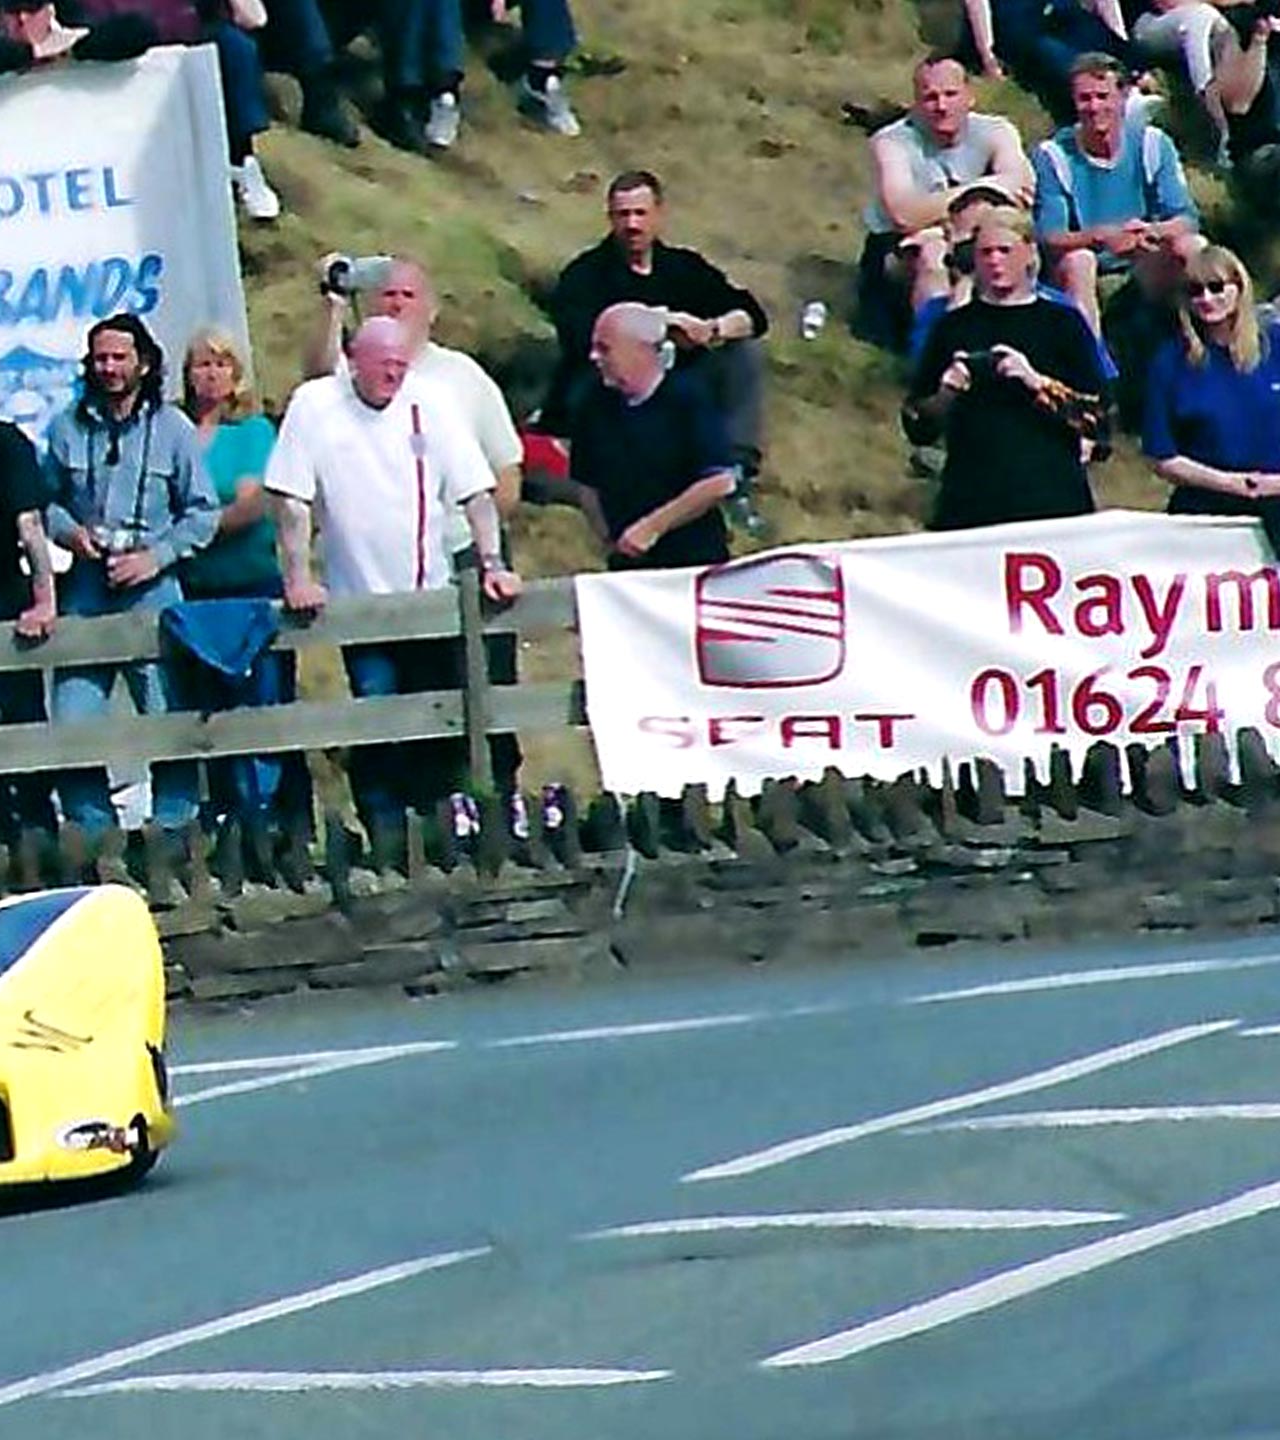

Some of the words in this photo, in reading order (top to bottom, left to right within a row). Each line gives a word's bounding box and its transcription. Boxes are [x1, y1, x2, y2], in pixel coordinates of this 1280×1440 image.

[1004, 551, 1280, 661] Raym
[638, 712, 916, 750] SEAT
[970, 664, 1225, 737] 01624
